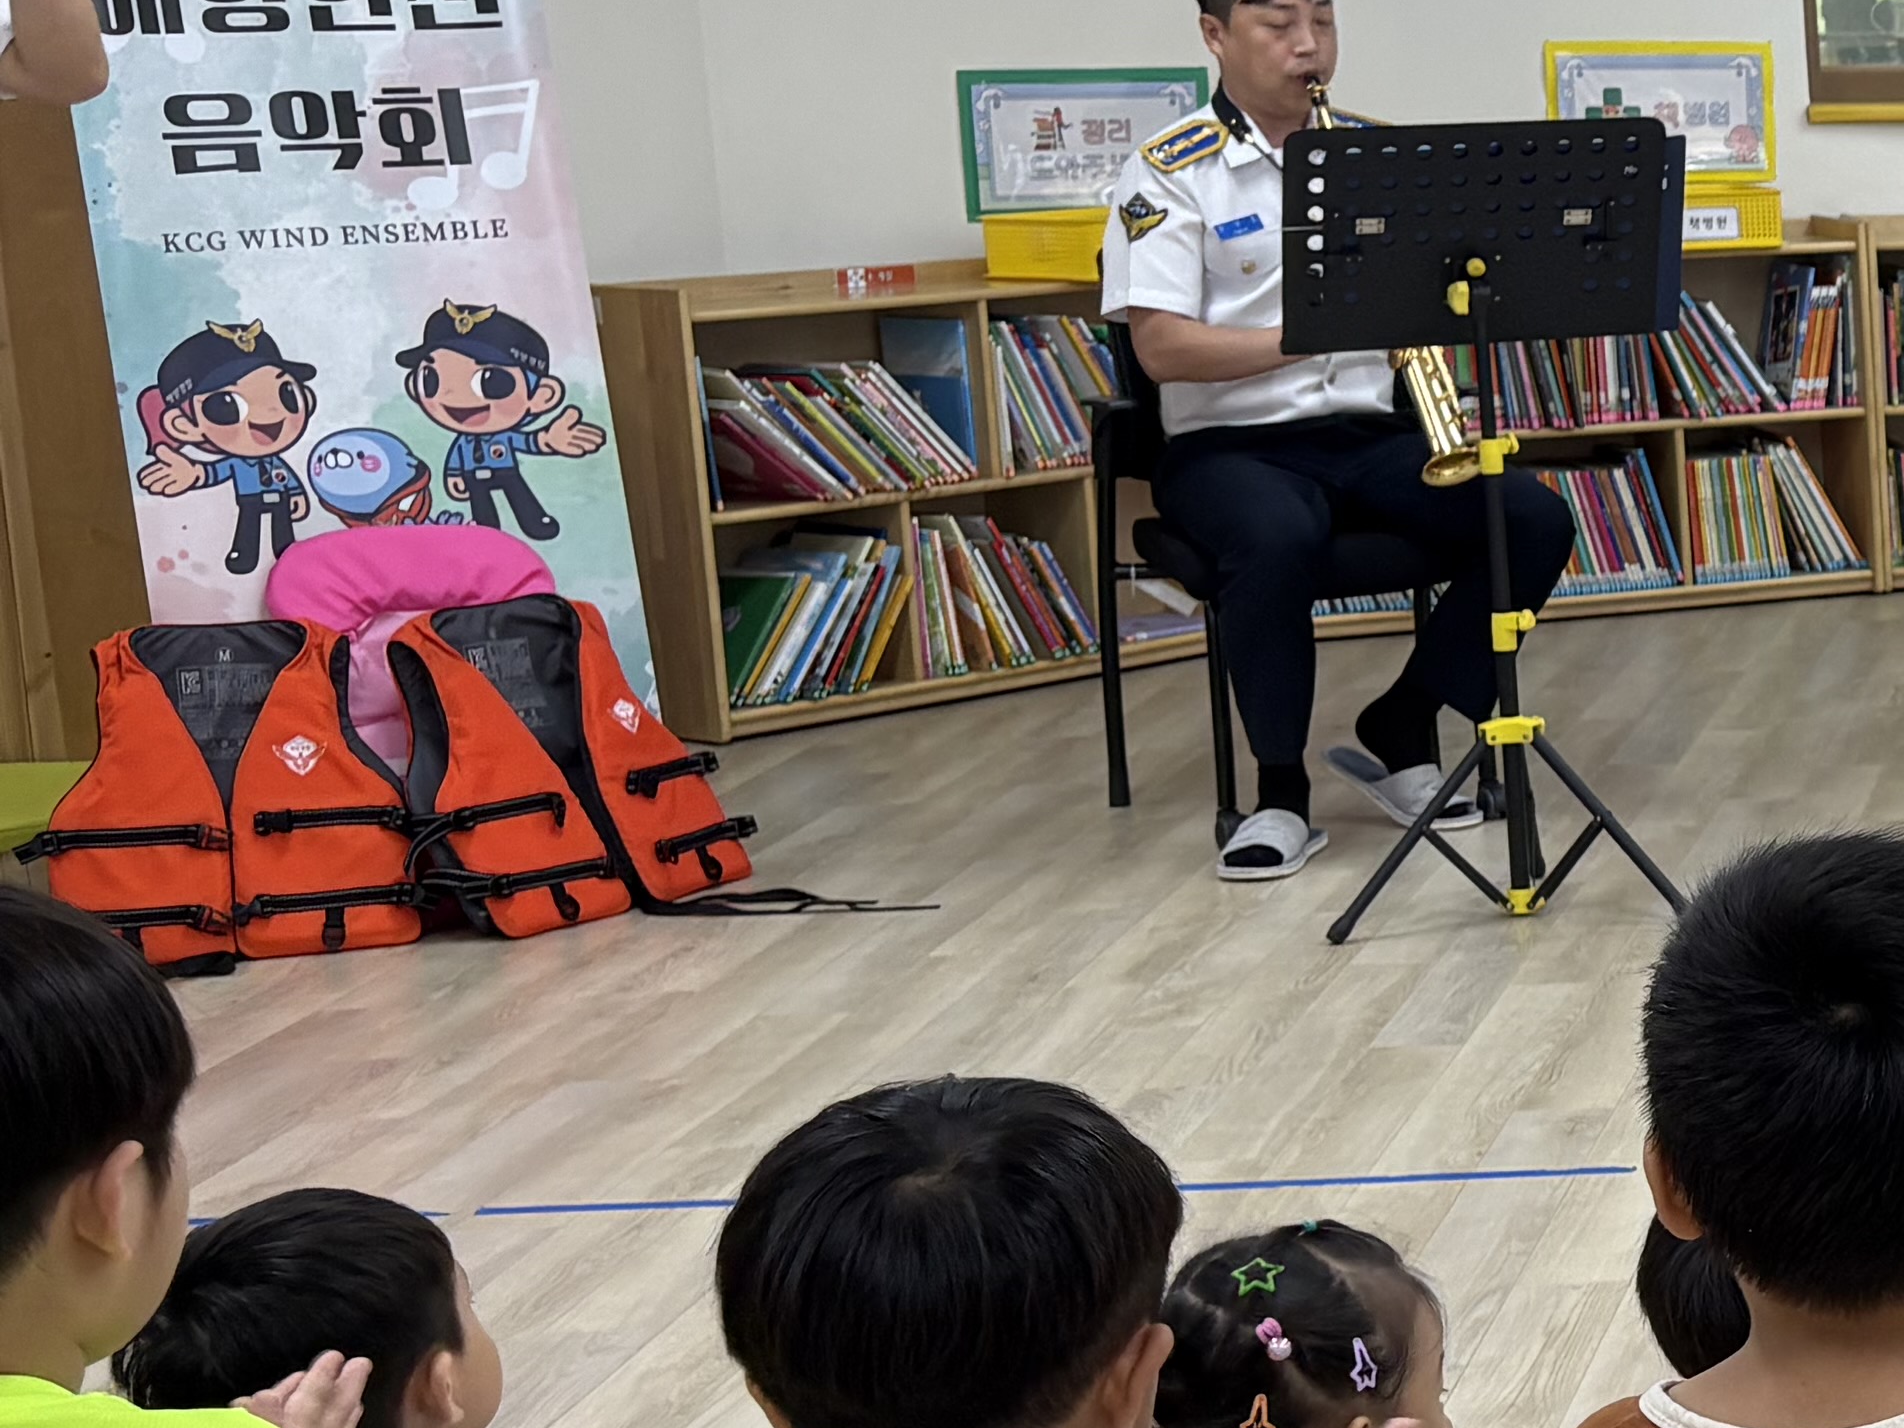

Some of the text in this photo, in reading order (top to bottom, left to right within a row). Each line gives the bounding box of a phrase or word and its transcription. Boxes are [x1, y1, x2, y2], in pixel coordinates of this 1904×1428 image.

[161, 86, 473, 176] 음악회
[161, 218, 510, 254] KCG WIND ENSEMBLE
